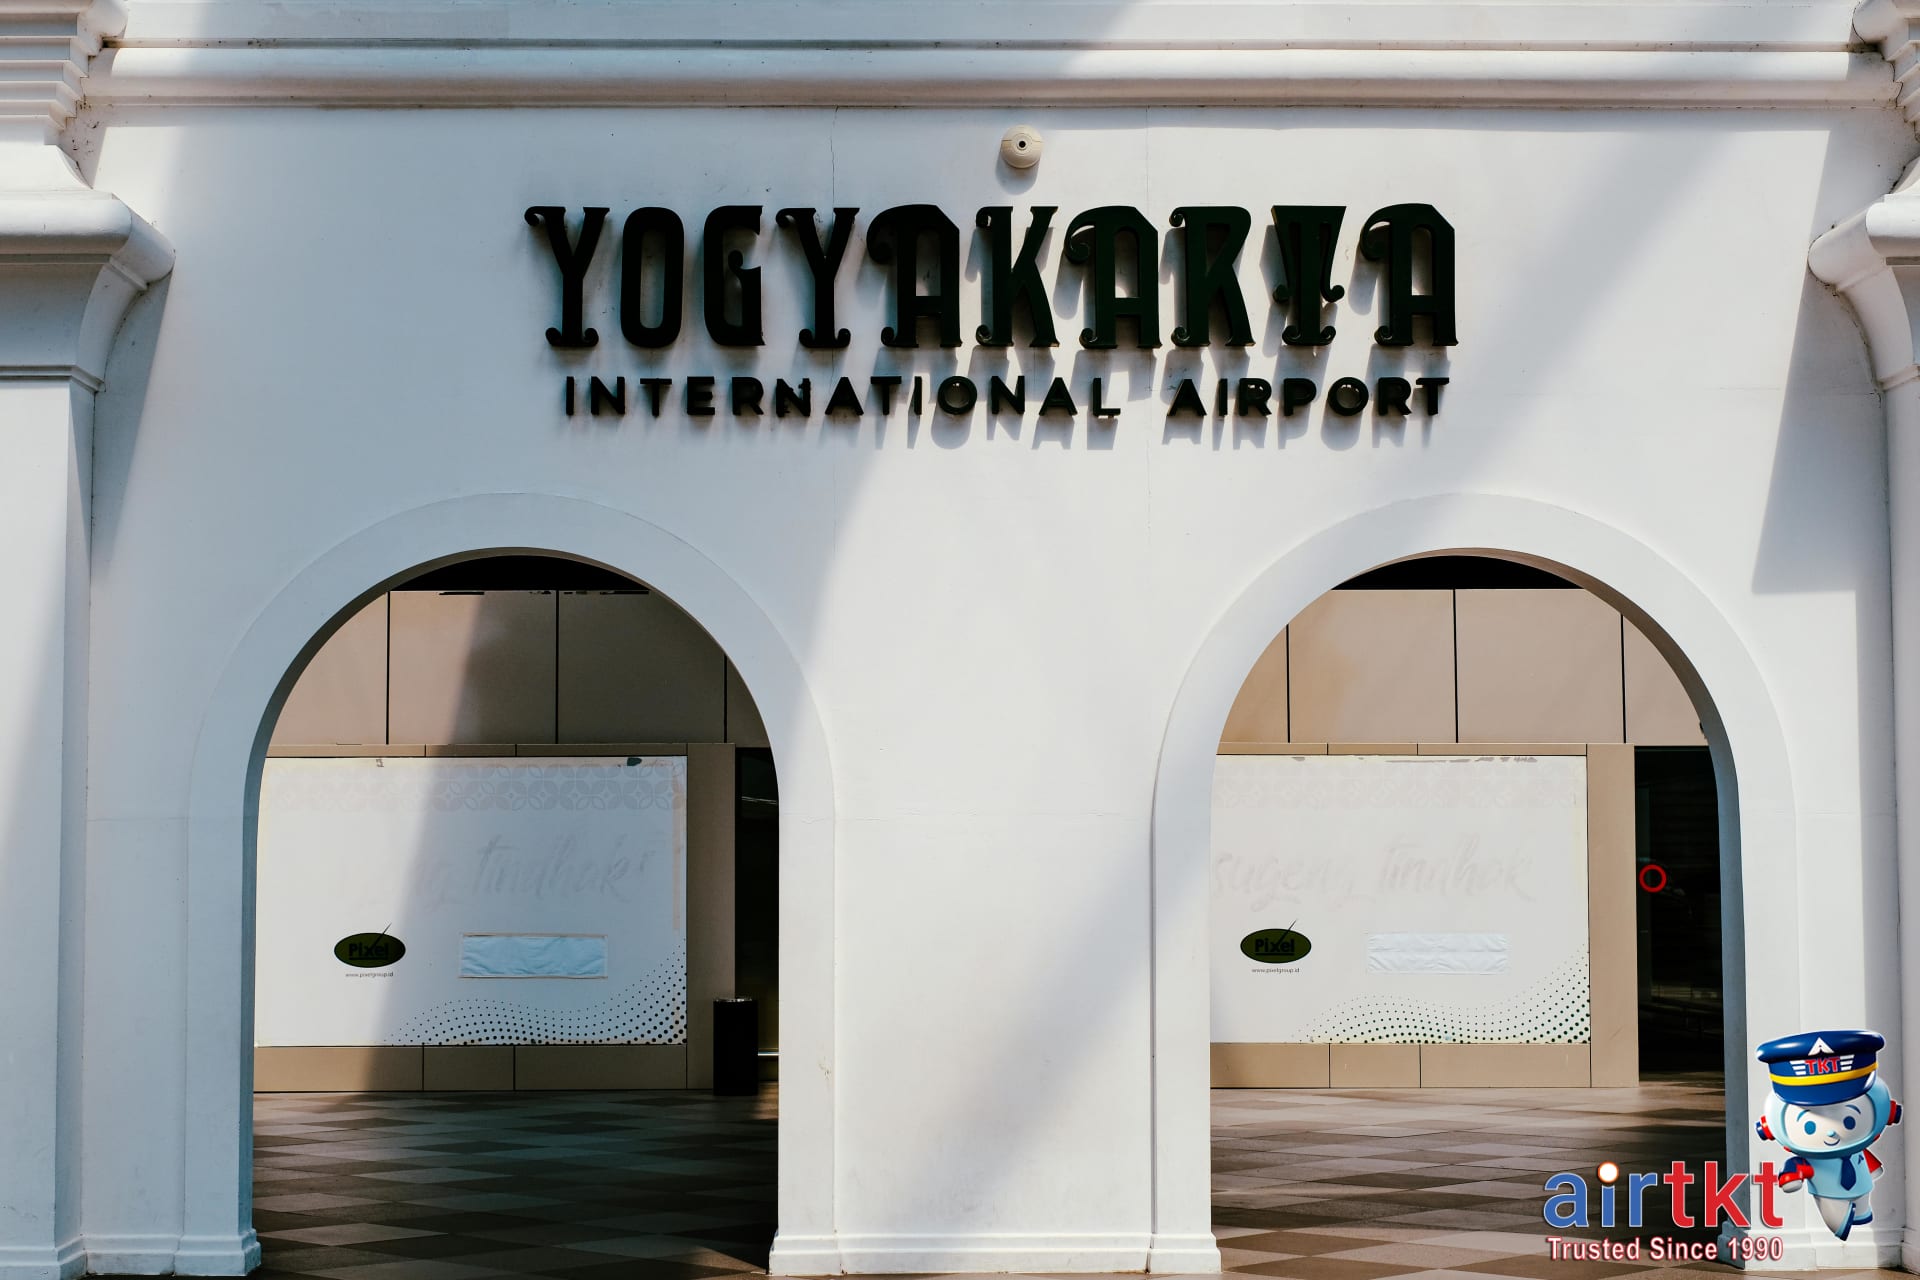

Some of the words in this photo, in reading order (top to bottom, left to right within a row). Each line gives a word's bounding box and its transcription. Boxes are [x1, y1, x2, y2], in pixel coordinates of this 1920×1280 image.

[524, 203, 1459, 349] YOGYAKARTA
[565, 375, 1121, 418] INTERNATIONAL
[1166, 377, 1450, 417] AIRPORT
[349, 942, 390, 957] Pixel
[1255, 938, 1296, 953] Pixel
